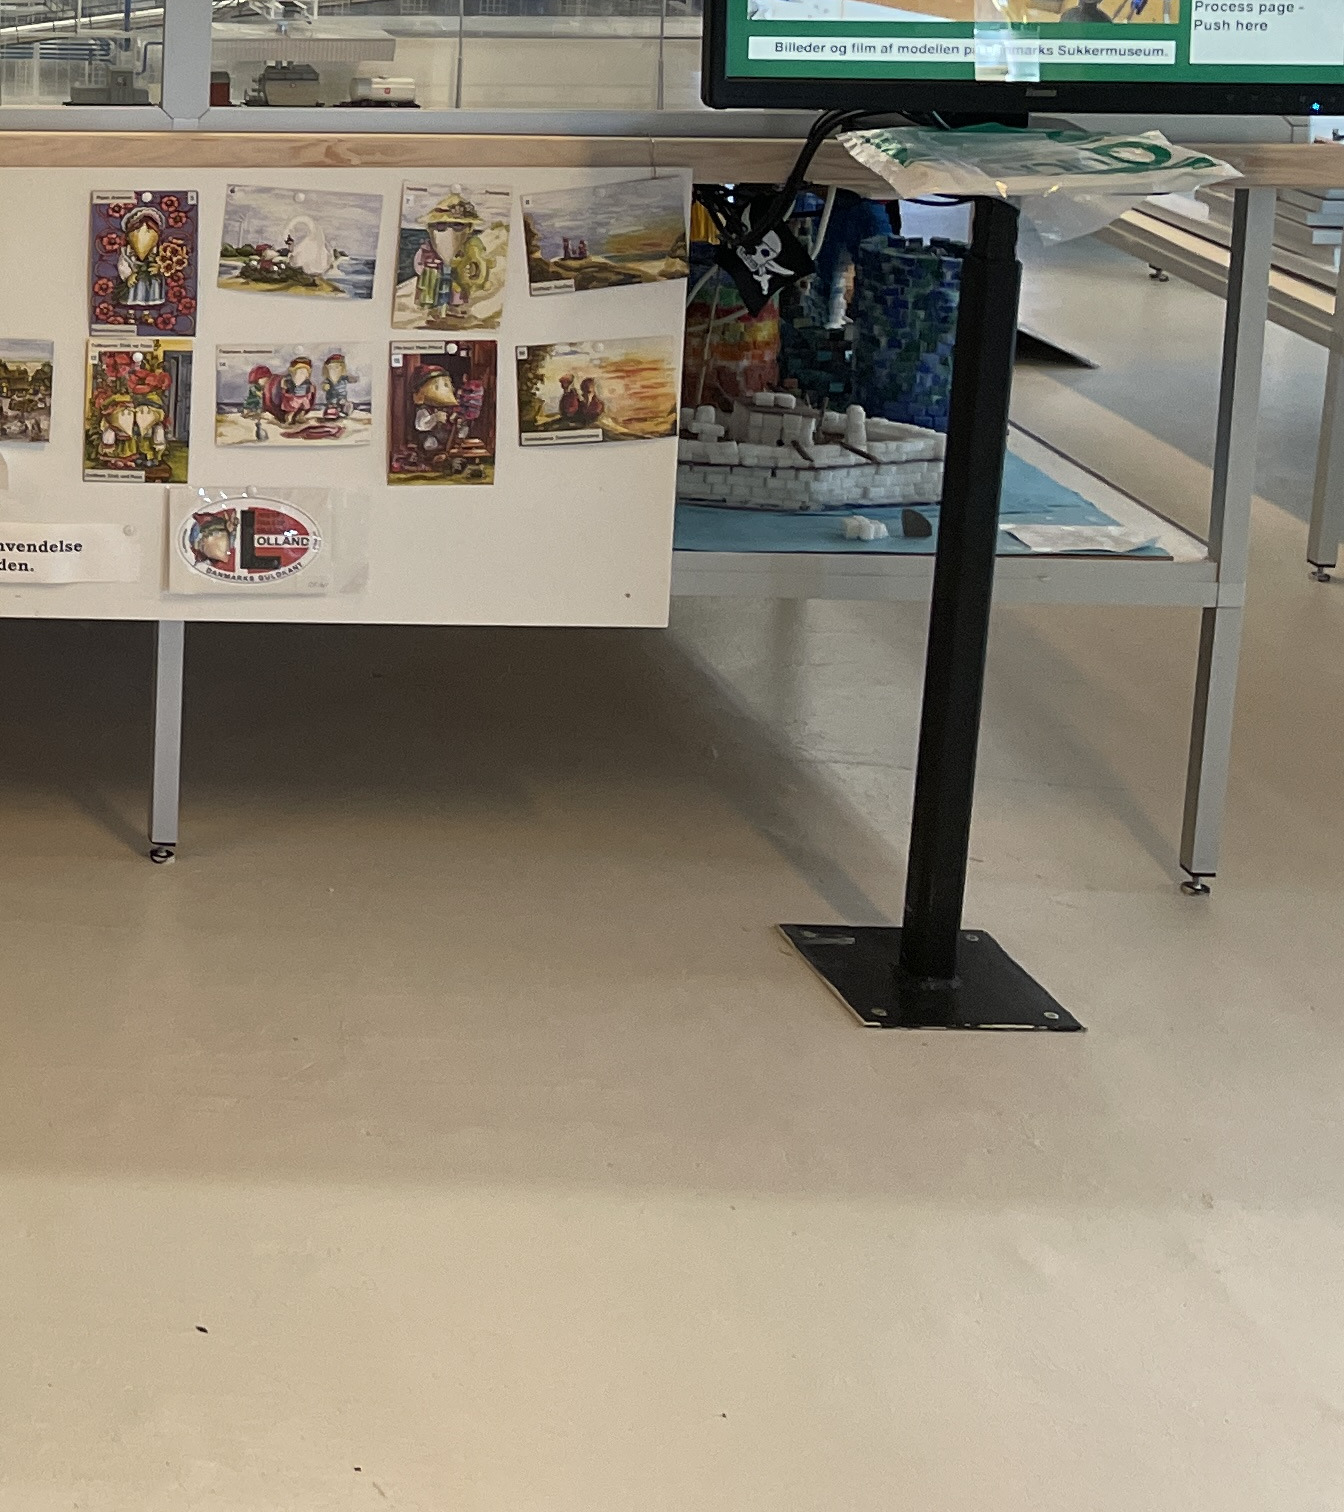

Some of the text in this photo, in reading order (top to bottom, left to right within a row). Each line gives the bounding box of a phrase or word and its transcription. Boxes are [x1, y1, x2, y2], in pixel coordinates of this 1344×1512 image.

[1195, 1, 1254, 12] Process
[1259, 3, 1295, 15] page
[1194, 20, 1268, 31] Push here
[775, 42, 825, 53] Billeder
[830, 45, 847, 56] og
[851, 43, 876, 54] film
[881, 44, 894, 54] af
[898, 44, 960, 55] modellen
[1058, 45, 1169, 58] Sukkermuseum.
[206, 567, 254, 582] DANMARKS
